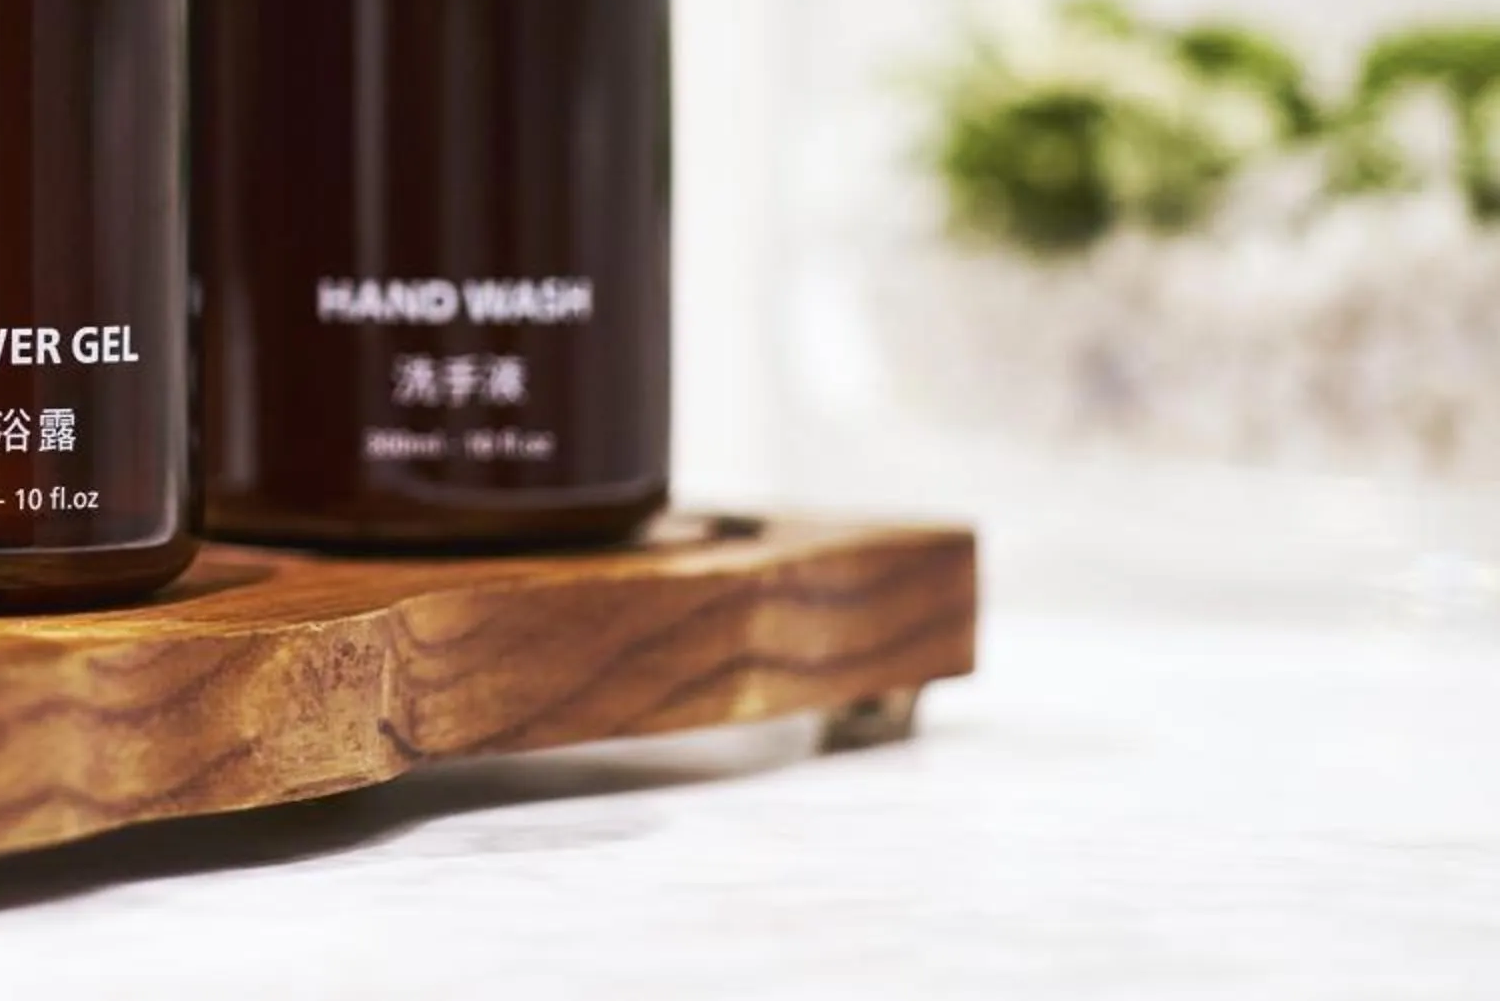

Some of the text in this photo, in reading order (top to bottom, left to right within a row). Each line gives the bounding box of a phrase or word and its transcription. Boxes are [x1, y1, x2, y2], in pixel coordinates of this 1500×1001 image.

[317, 277, 593, 323] HAND WASH
[71, 324, 139, 365] GEL
[14, 487, 43, 512] 10
[49, 486, 100, 510] fl.oz
